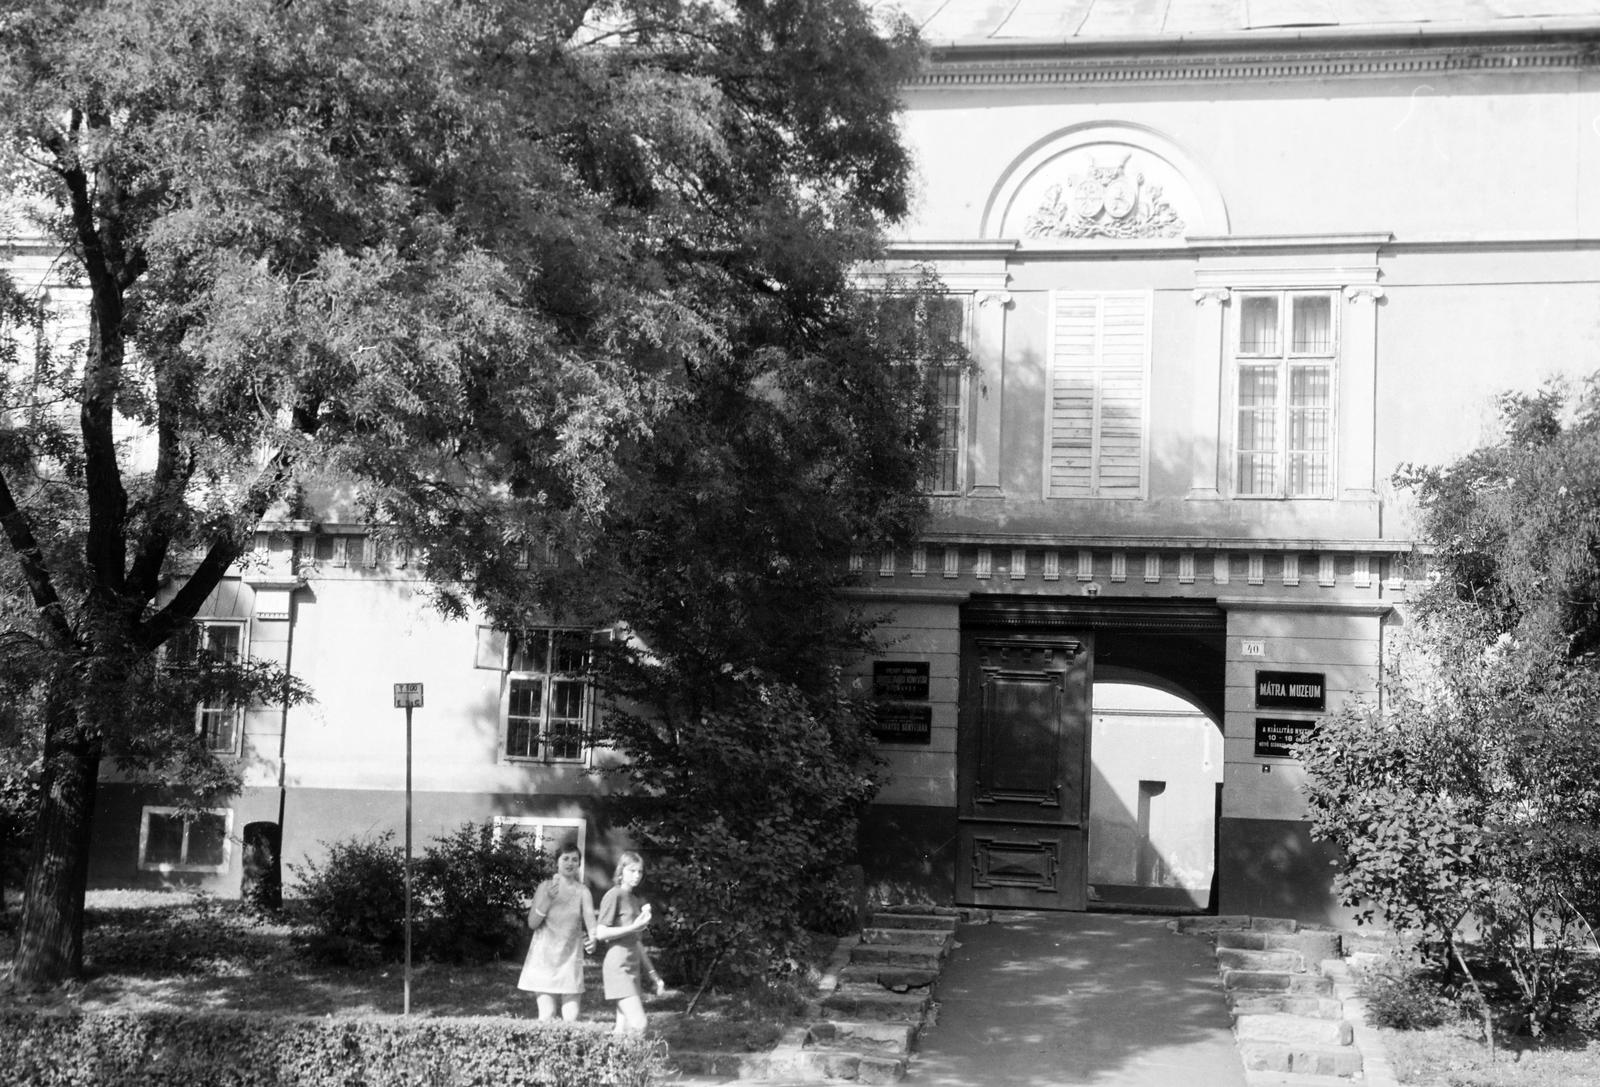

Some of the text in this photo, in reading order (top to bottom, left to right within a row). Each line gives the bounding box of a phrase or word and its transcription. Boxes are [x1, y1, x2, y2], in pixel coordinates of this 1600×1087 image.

[1247, 643, 1259, 654] 40
[1259, 681, 1321, 698] MÁTRA MUZEUM
